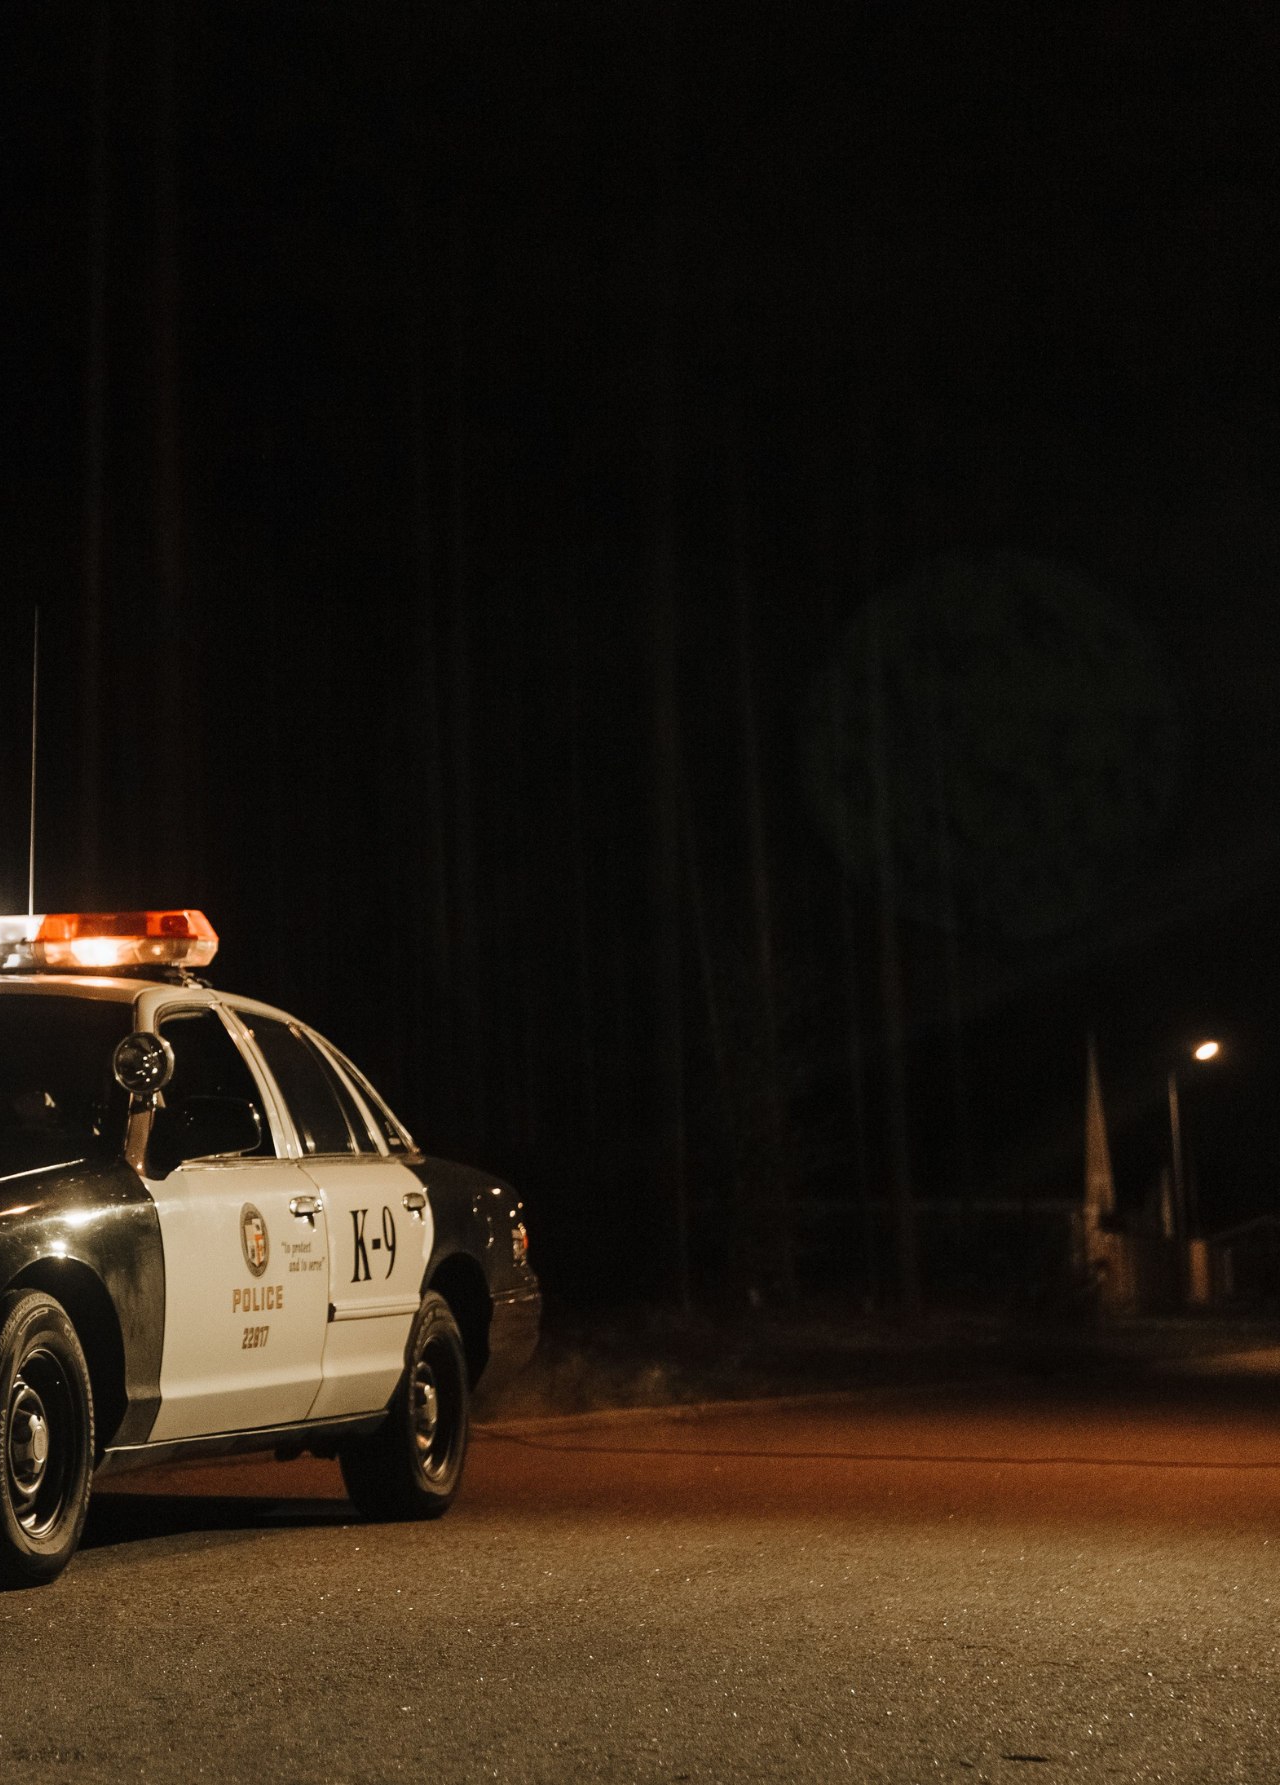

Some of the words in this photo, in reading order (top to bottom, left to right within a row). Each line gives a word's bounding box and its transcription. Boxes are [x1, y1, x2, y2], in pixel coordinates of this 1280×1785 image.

[291, 1241, 311, 1256] protect
[348, 1205, 397, 1283] K-9
[288, 1257, 300, 1271] and
[300, 1258, 307, 1271] to
[233, 1285, 283, 1313] POLICE
